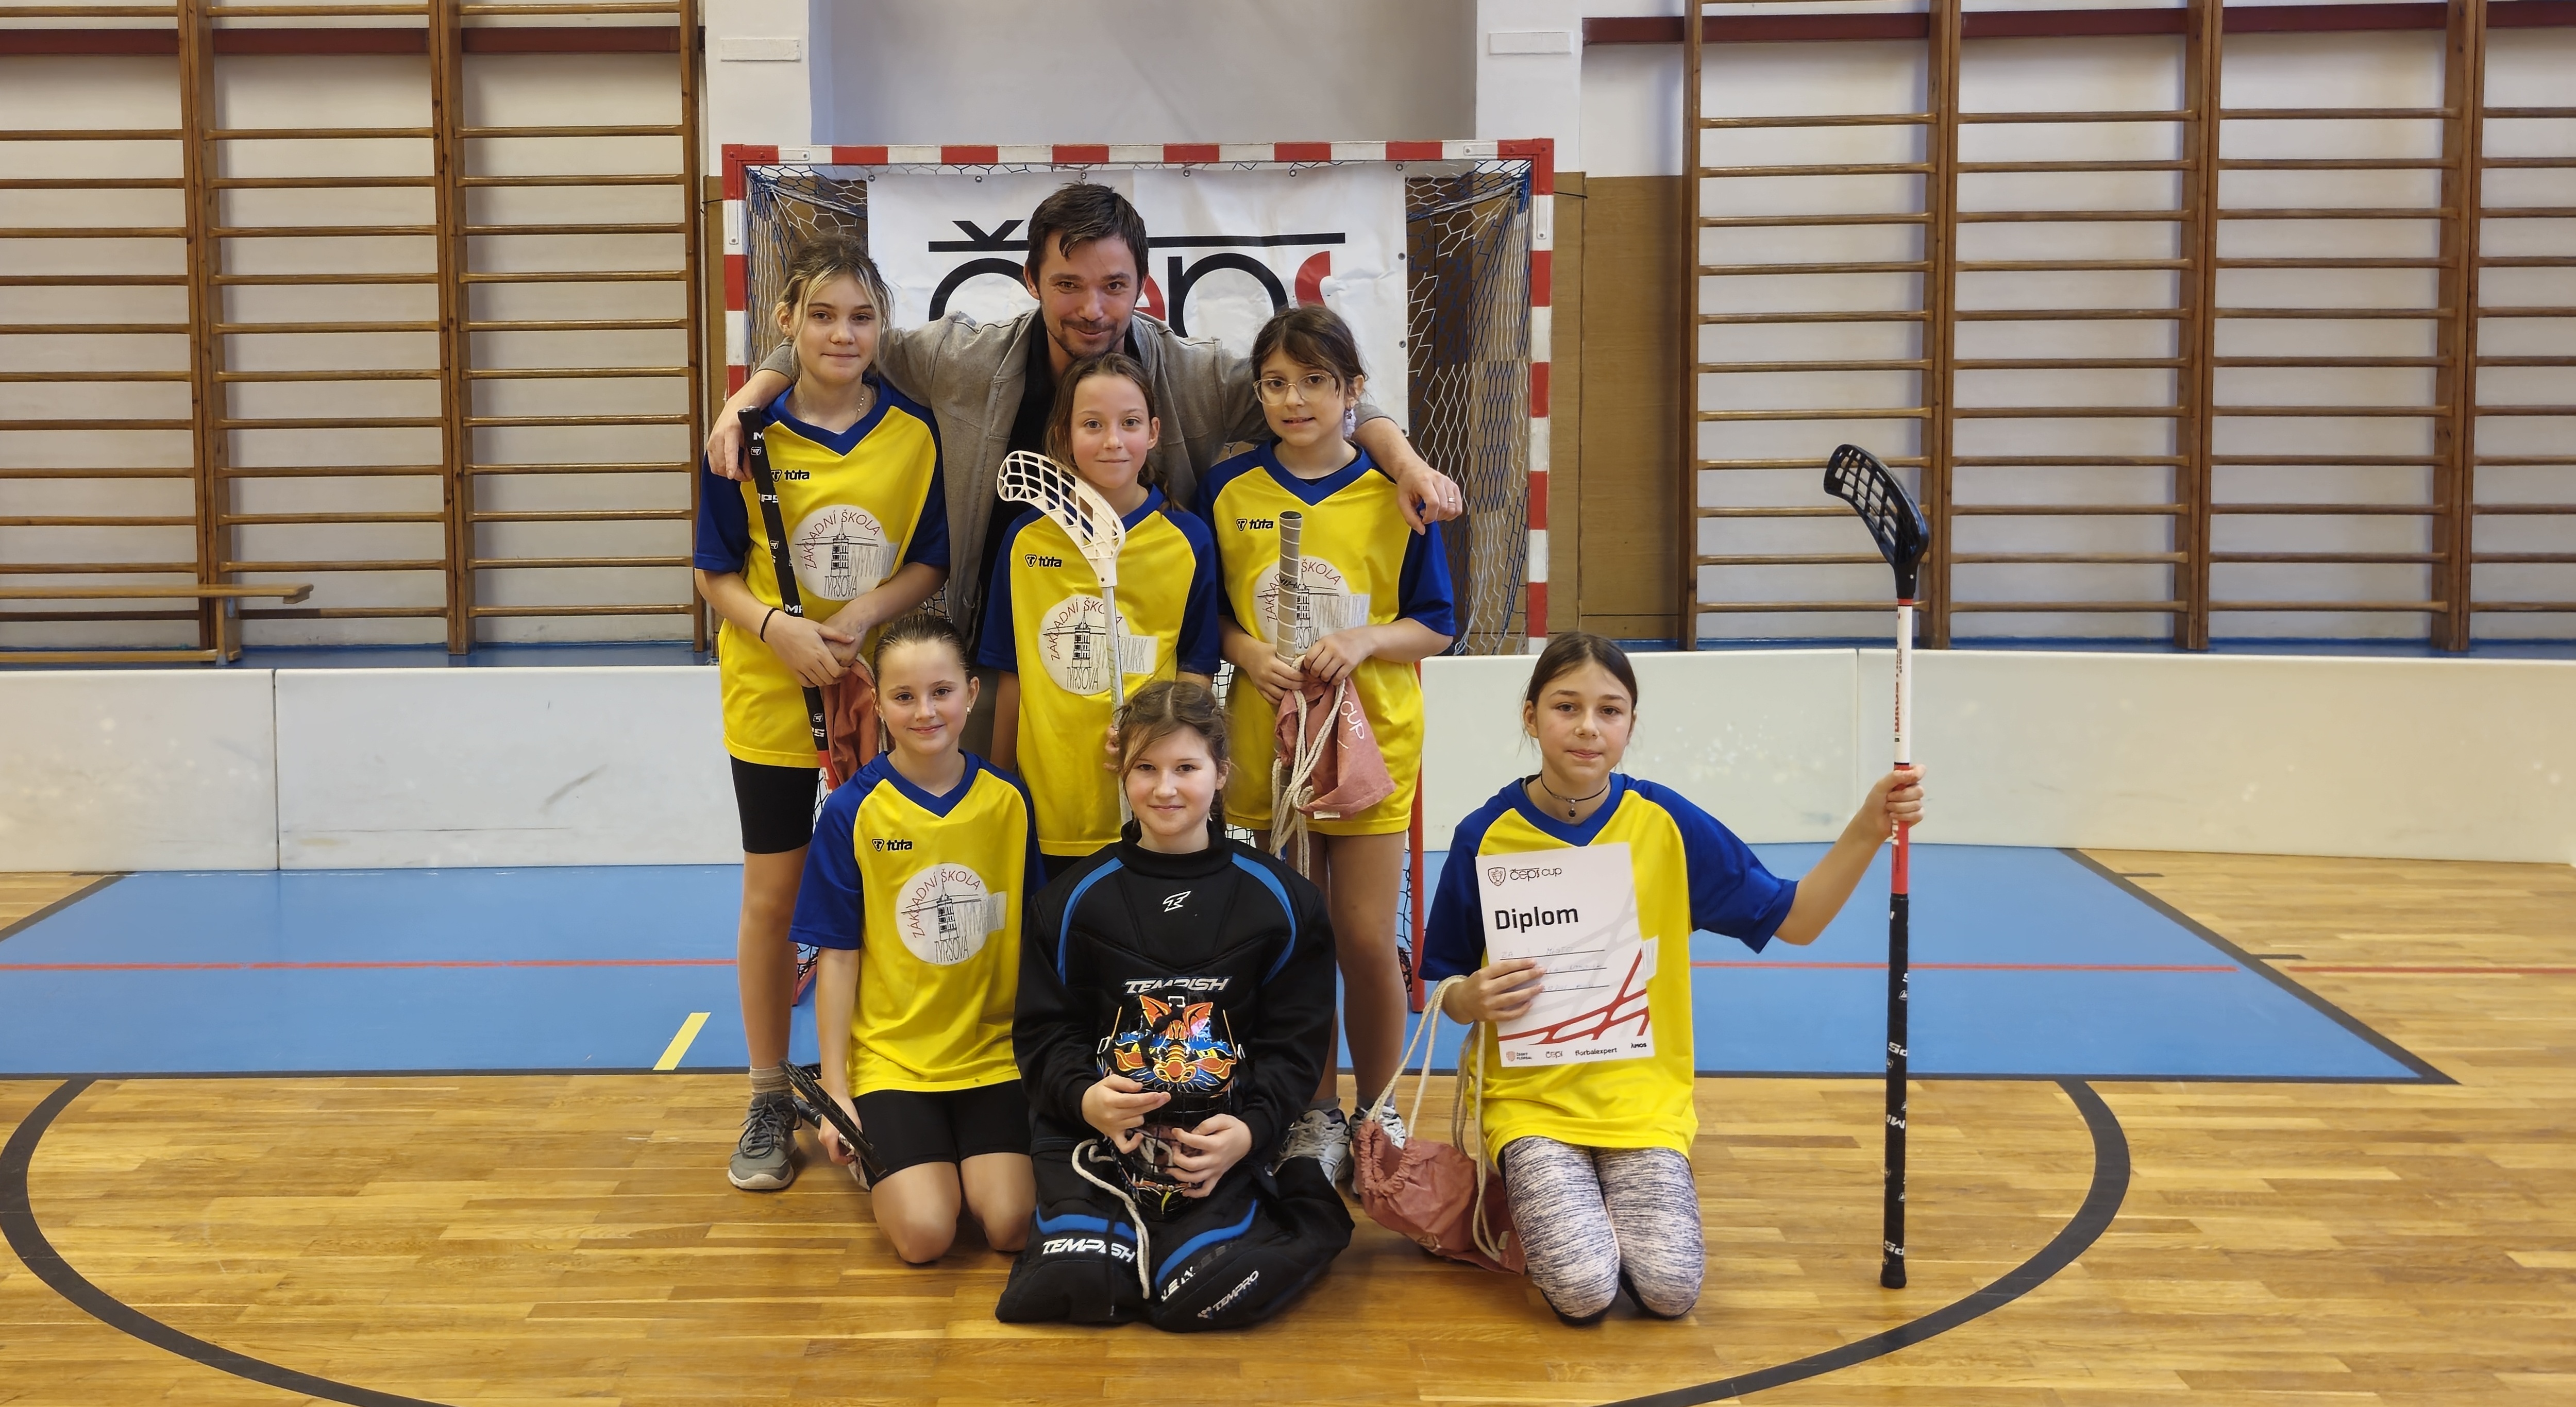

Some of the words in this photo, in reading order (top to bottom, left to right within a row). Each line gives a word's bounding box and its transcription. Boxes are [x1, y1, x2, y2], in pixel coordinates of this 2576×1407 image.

[801, 510, 836, 570] ZÁKLADNÍ
[841, 508, 880, 536] ŠKOLA
[1301, 558, 1341, 585] ŠKOLA
[1084, 597, 1123, 624] ŠKOA
[907, 872, 938, 938] ZÁKLADNÍ
[941, 869, 981, 890] ŠKOLA
[1495, 906, 1578, 934] Diplom
[1213, 1270, 1259, 1311] TEMPRO
